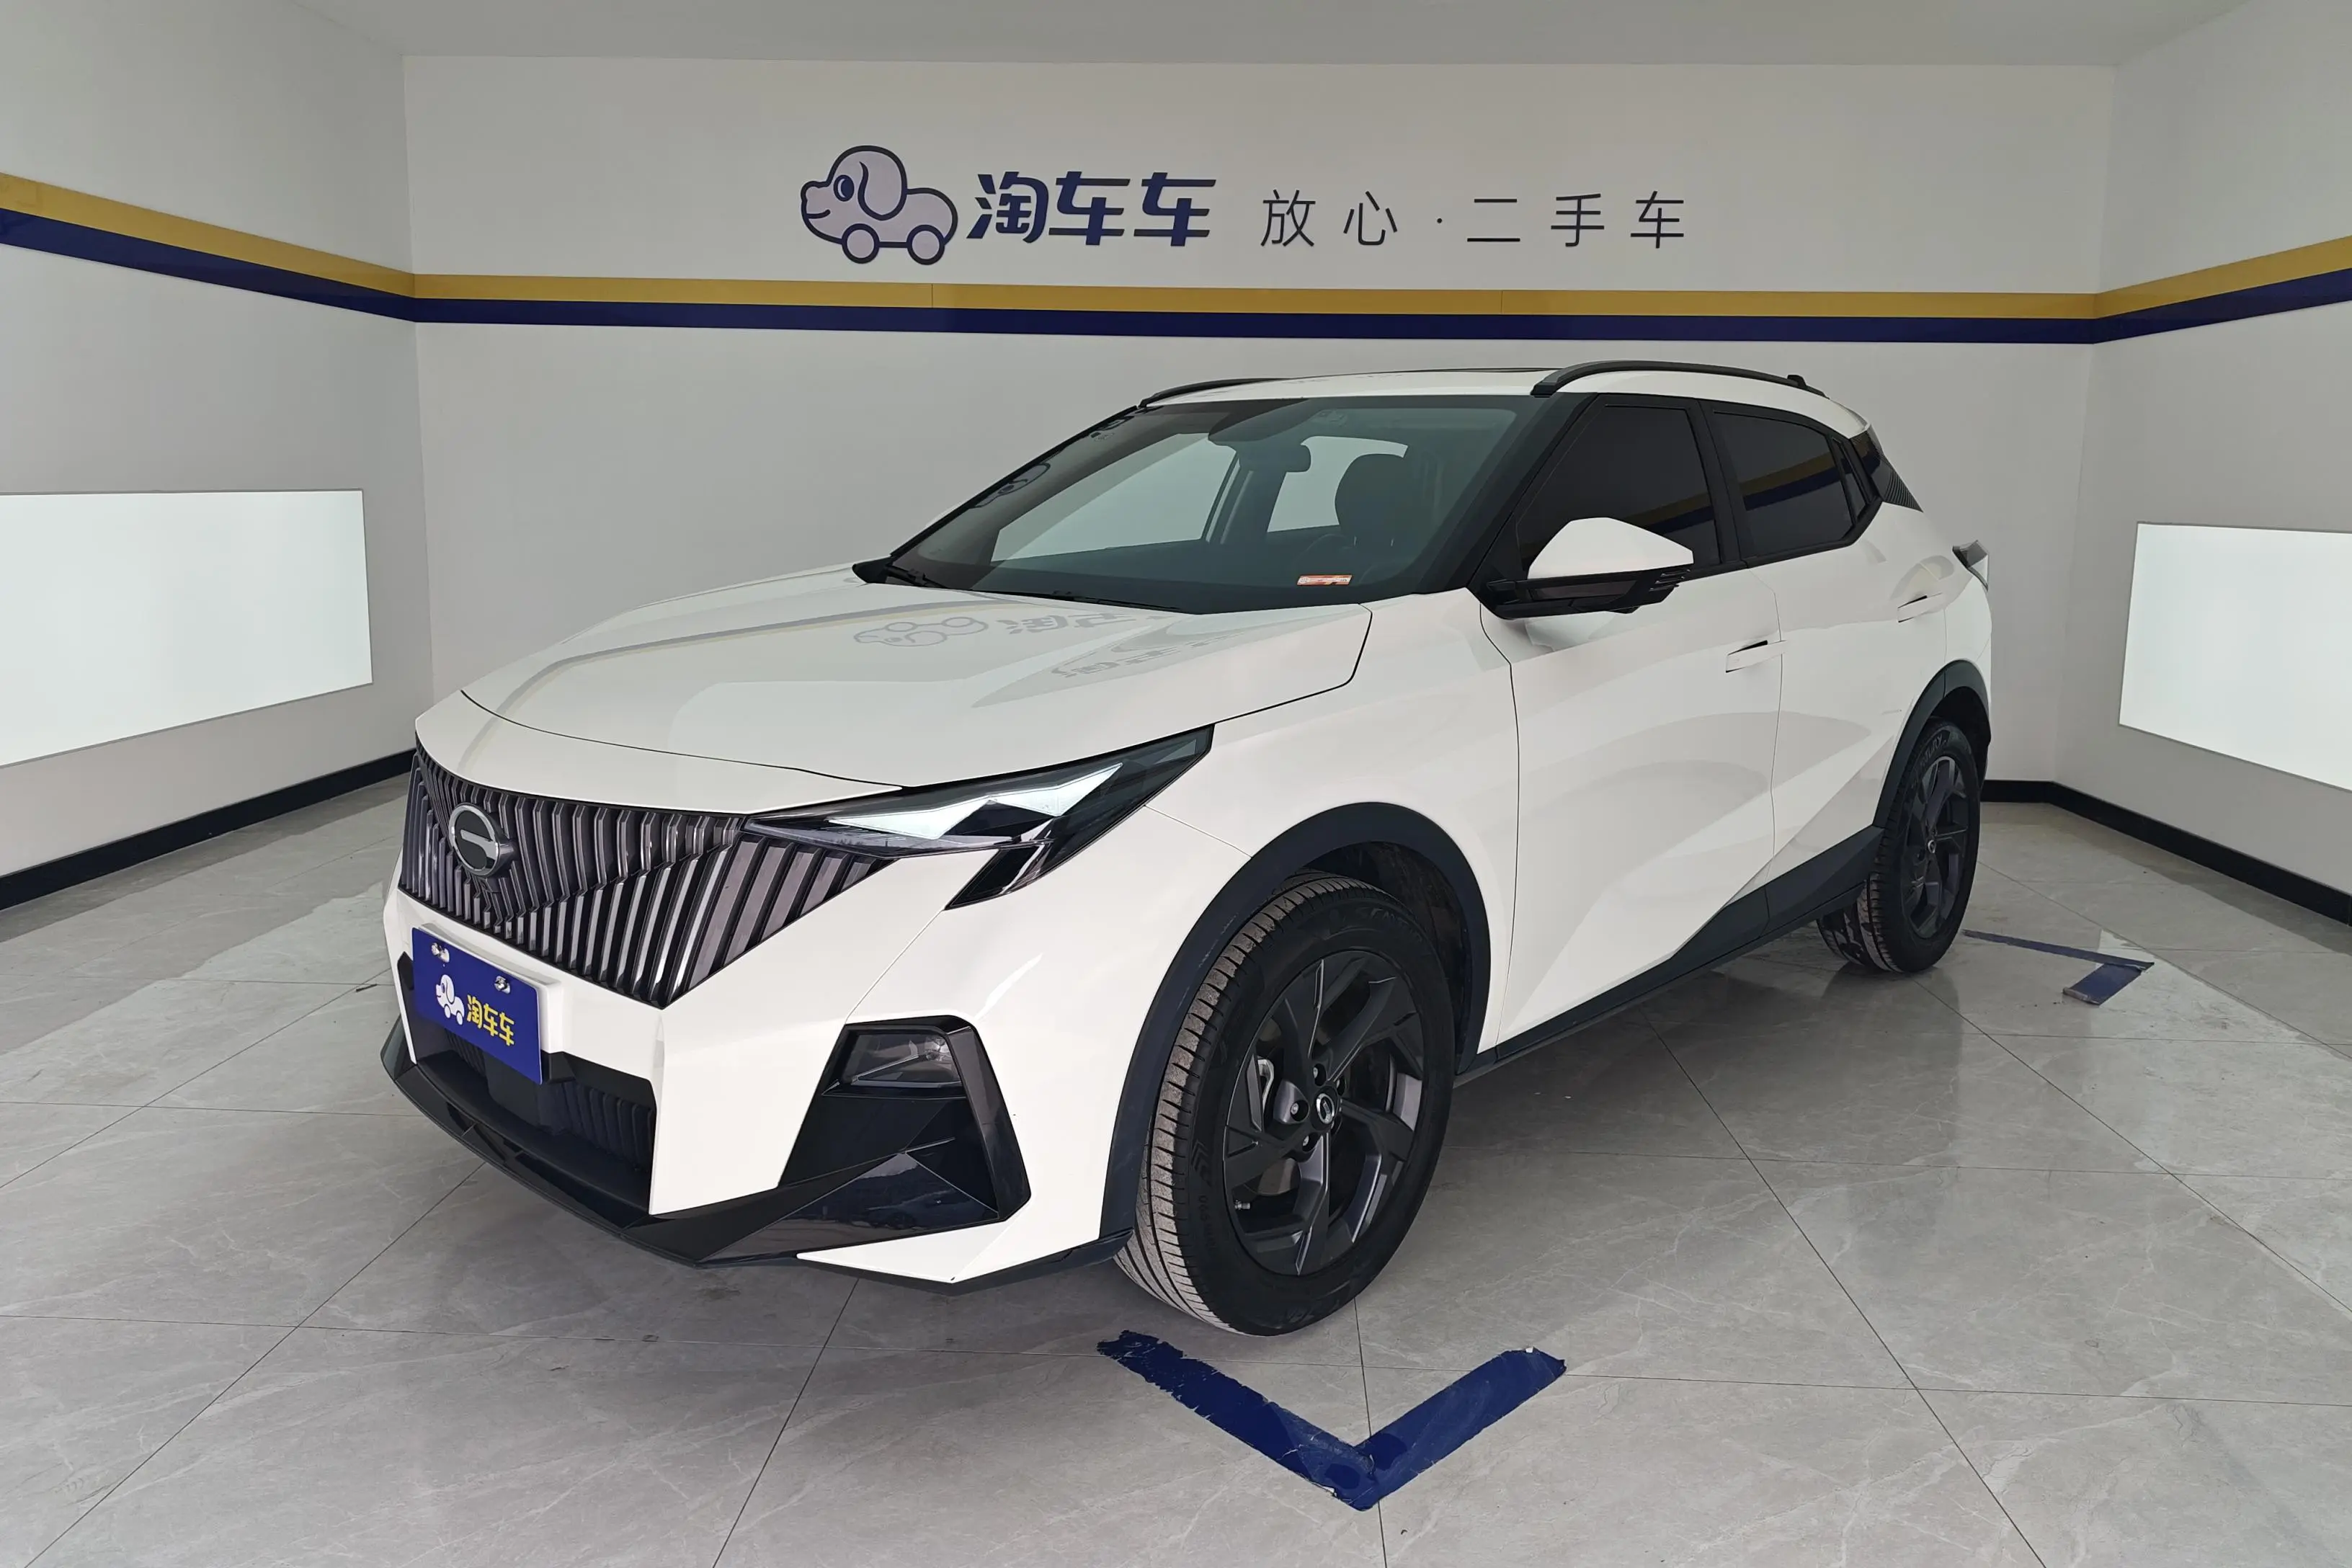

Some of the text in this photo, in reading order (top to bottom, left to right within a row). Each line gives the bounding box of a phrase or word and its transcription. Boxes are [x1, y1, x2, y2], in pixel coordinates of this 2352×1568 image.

[966, 171, 1217, 247] 淘车车
[467, 994, 514, 1046] 淘车车
